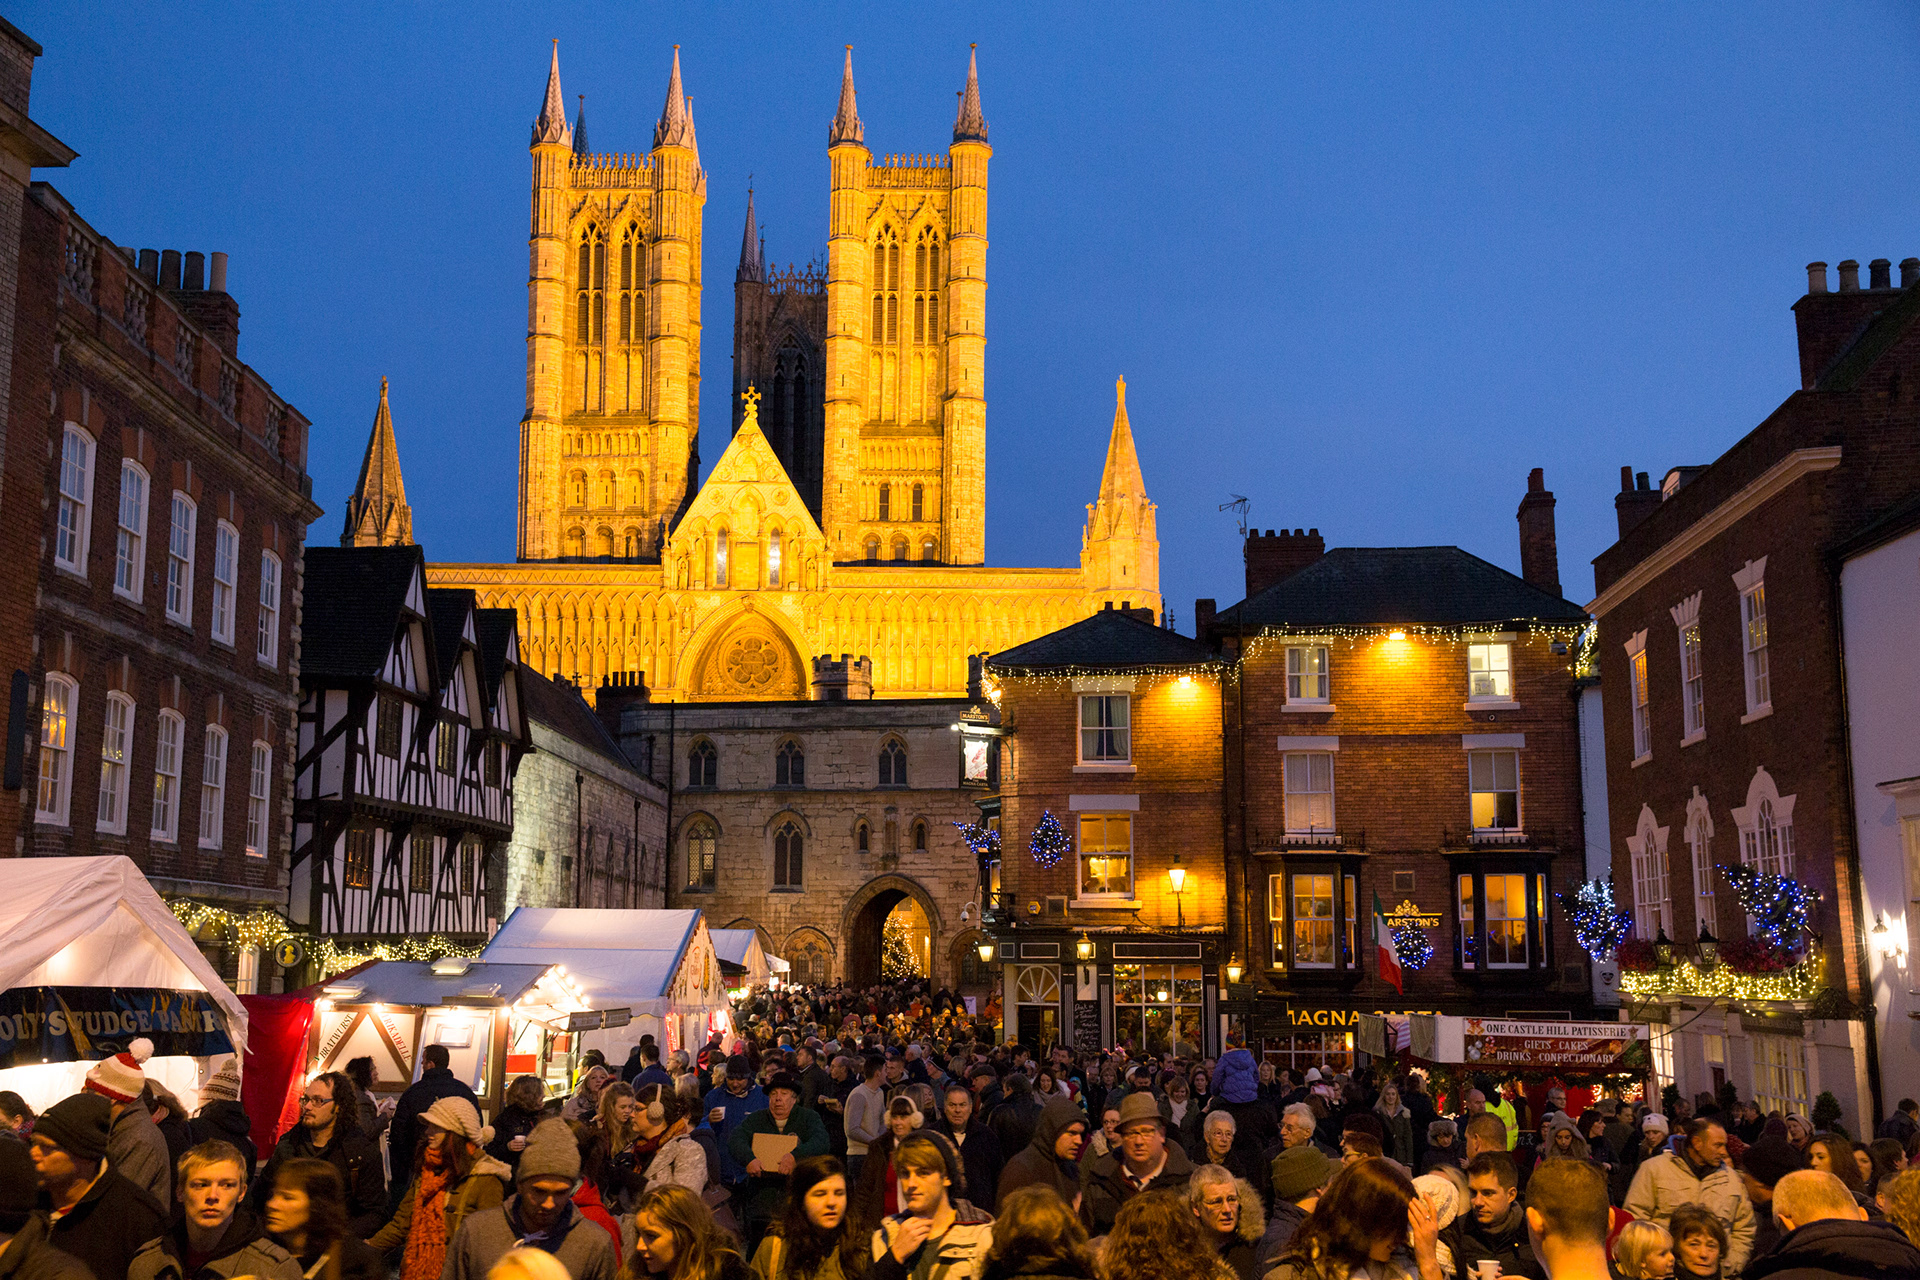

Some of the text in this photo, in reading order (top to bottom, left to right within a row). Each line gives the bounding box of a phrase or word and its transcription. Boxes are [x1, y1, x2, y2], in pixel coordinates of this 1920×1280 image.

[1387, 917, 1440, 927] ARSTON'S
[70, 1009, 153, 1036] FUDGE
[319, 1013, 354, 1059] BRATWURST
[1486, 1023, 1627, 1037] ONE CASTLE HILL PATISSERIE
[1524, 1039, 1589, 1051] GIFTS CAKES
[1496, 1050, 1615, 1064] DRINKS CONFECTIONARY
